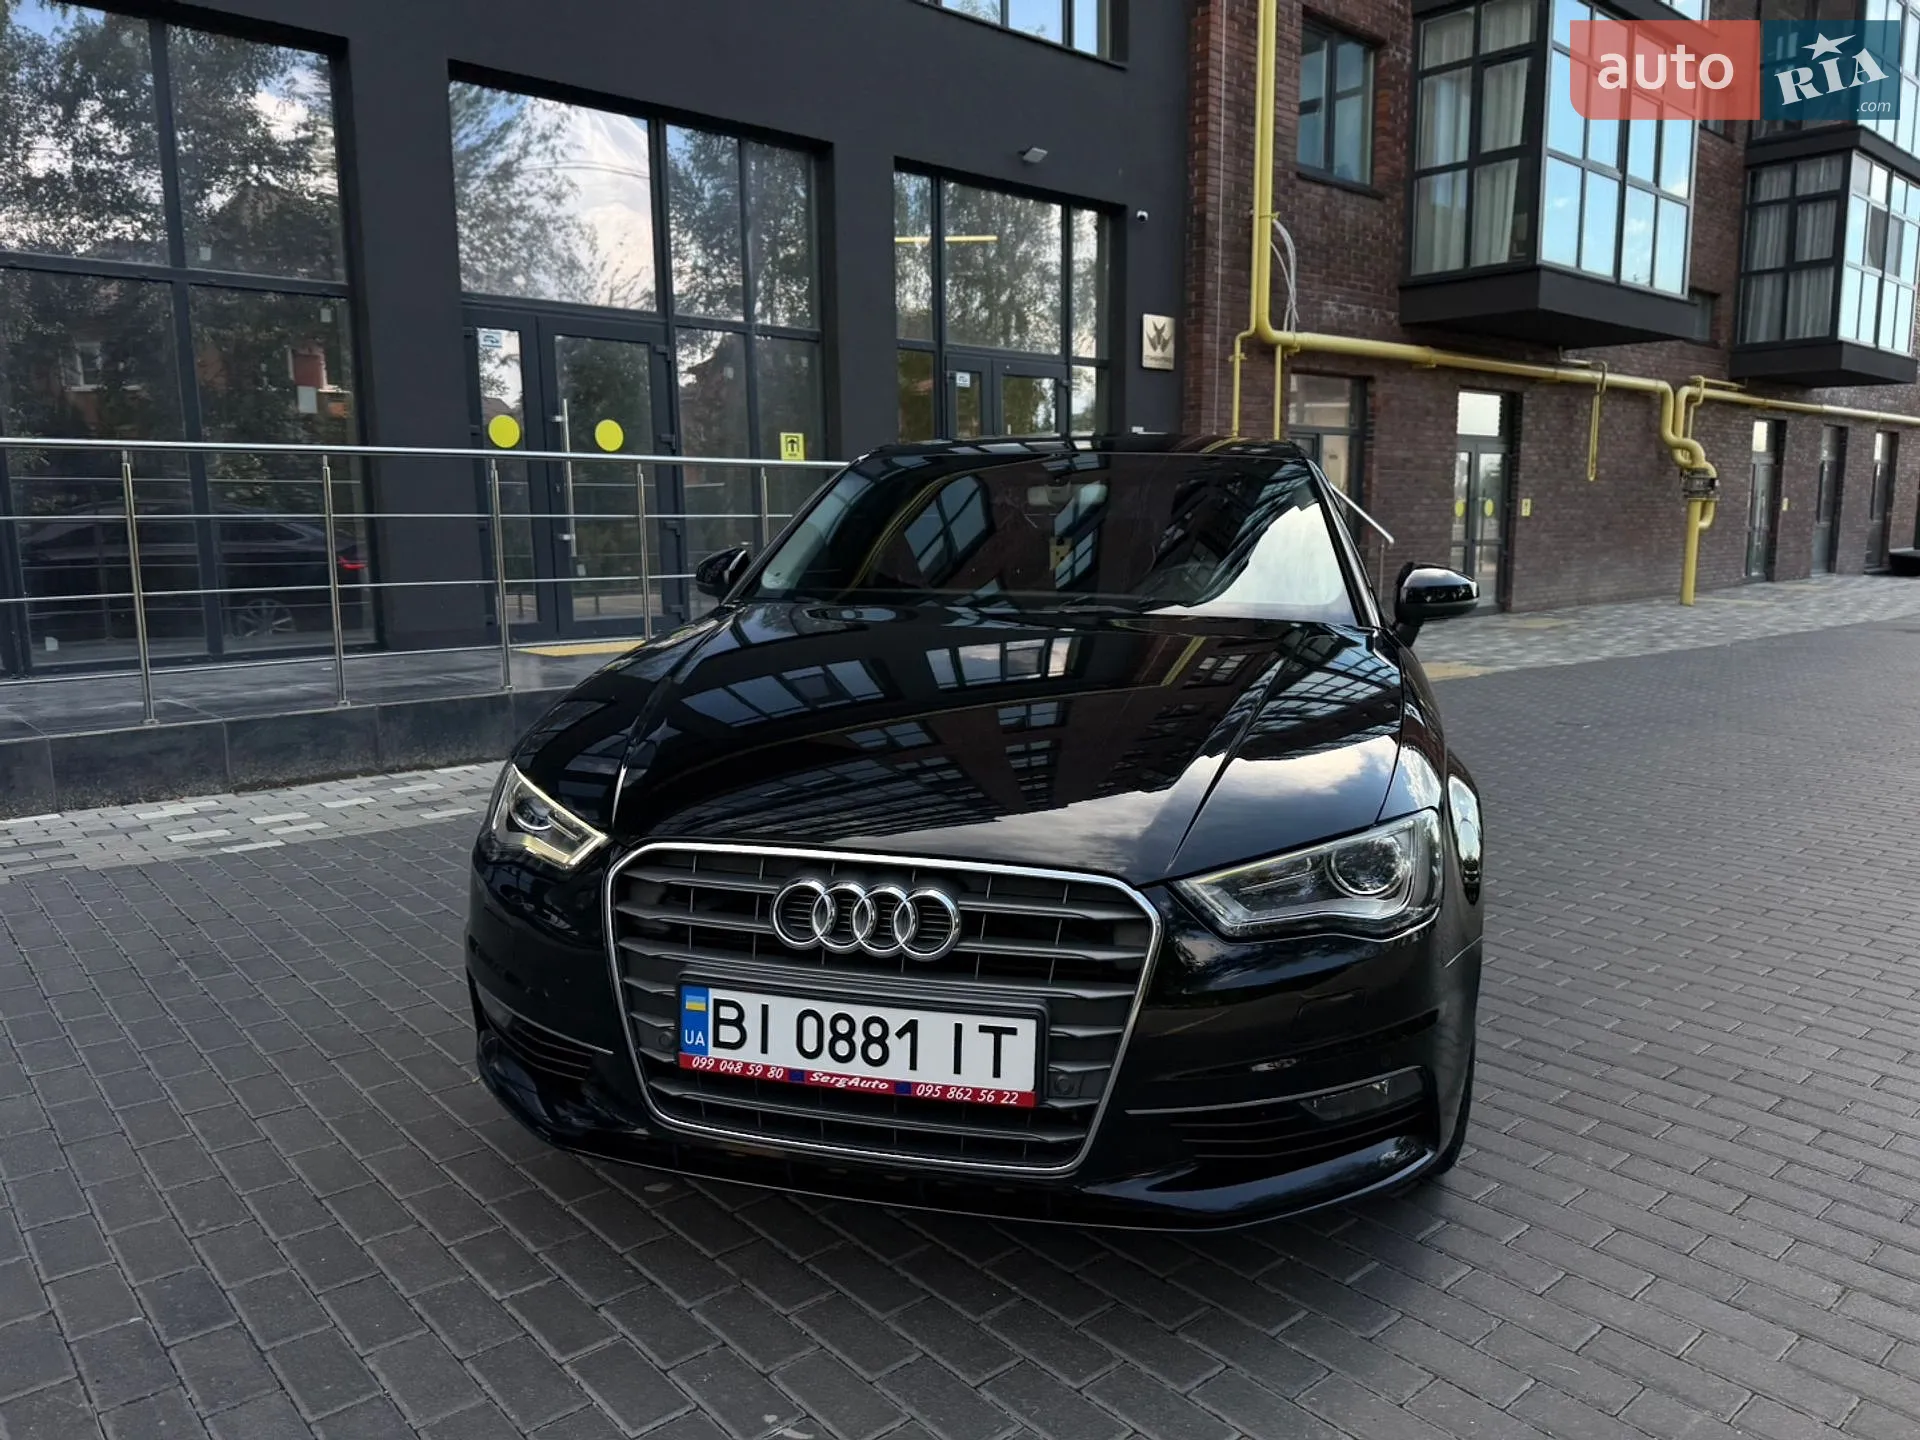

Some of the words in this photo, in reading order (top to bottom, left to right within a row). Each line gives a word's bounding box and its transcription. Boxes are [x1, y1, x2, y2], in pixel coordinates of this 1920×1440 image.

[685, 1029, 706, 1047] UA
[711, 998, 769, 1055] BI
[795, 1008, 919, 1072] 0881
[952, 1022, 1018, 1079] IT
[691, 1056, 715, 1070] 099
[719, 1060, 743, 1073] 048
[746, 1063, 763, 1076] 59
[767, 1066, 784, 1079] 80
[809, 1071, 889, 1090] SergAuto
[916, 1083, 942, 1097] 095
[946, 1086, 973, 1101] 862
[977, 1089, 996, 1103] 56
[1000, 1091, 1019, 1105] 22
